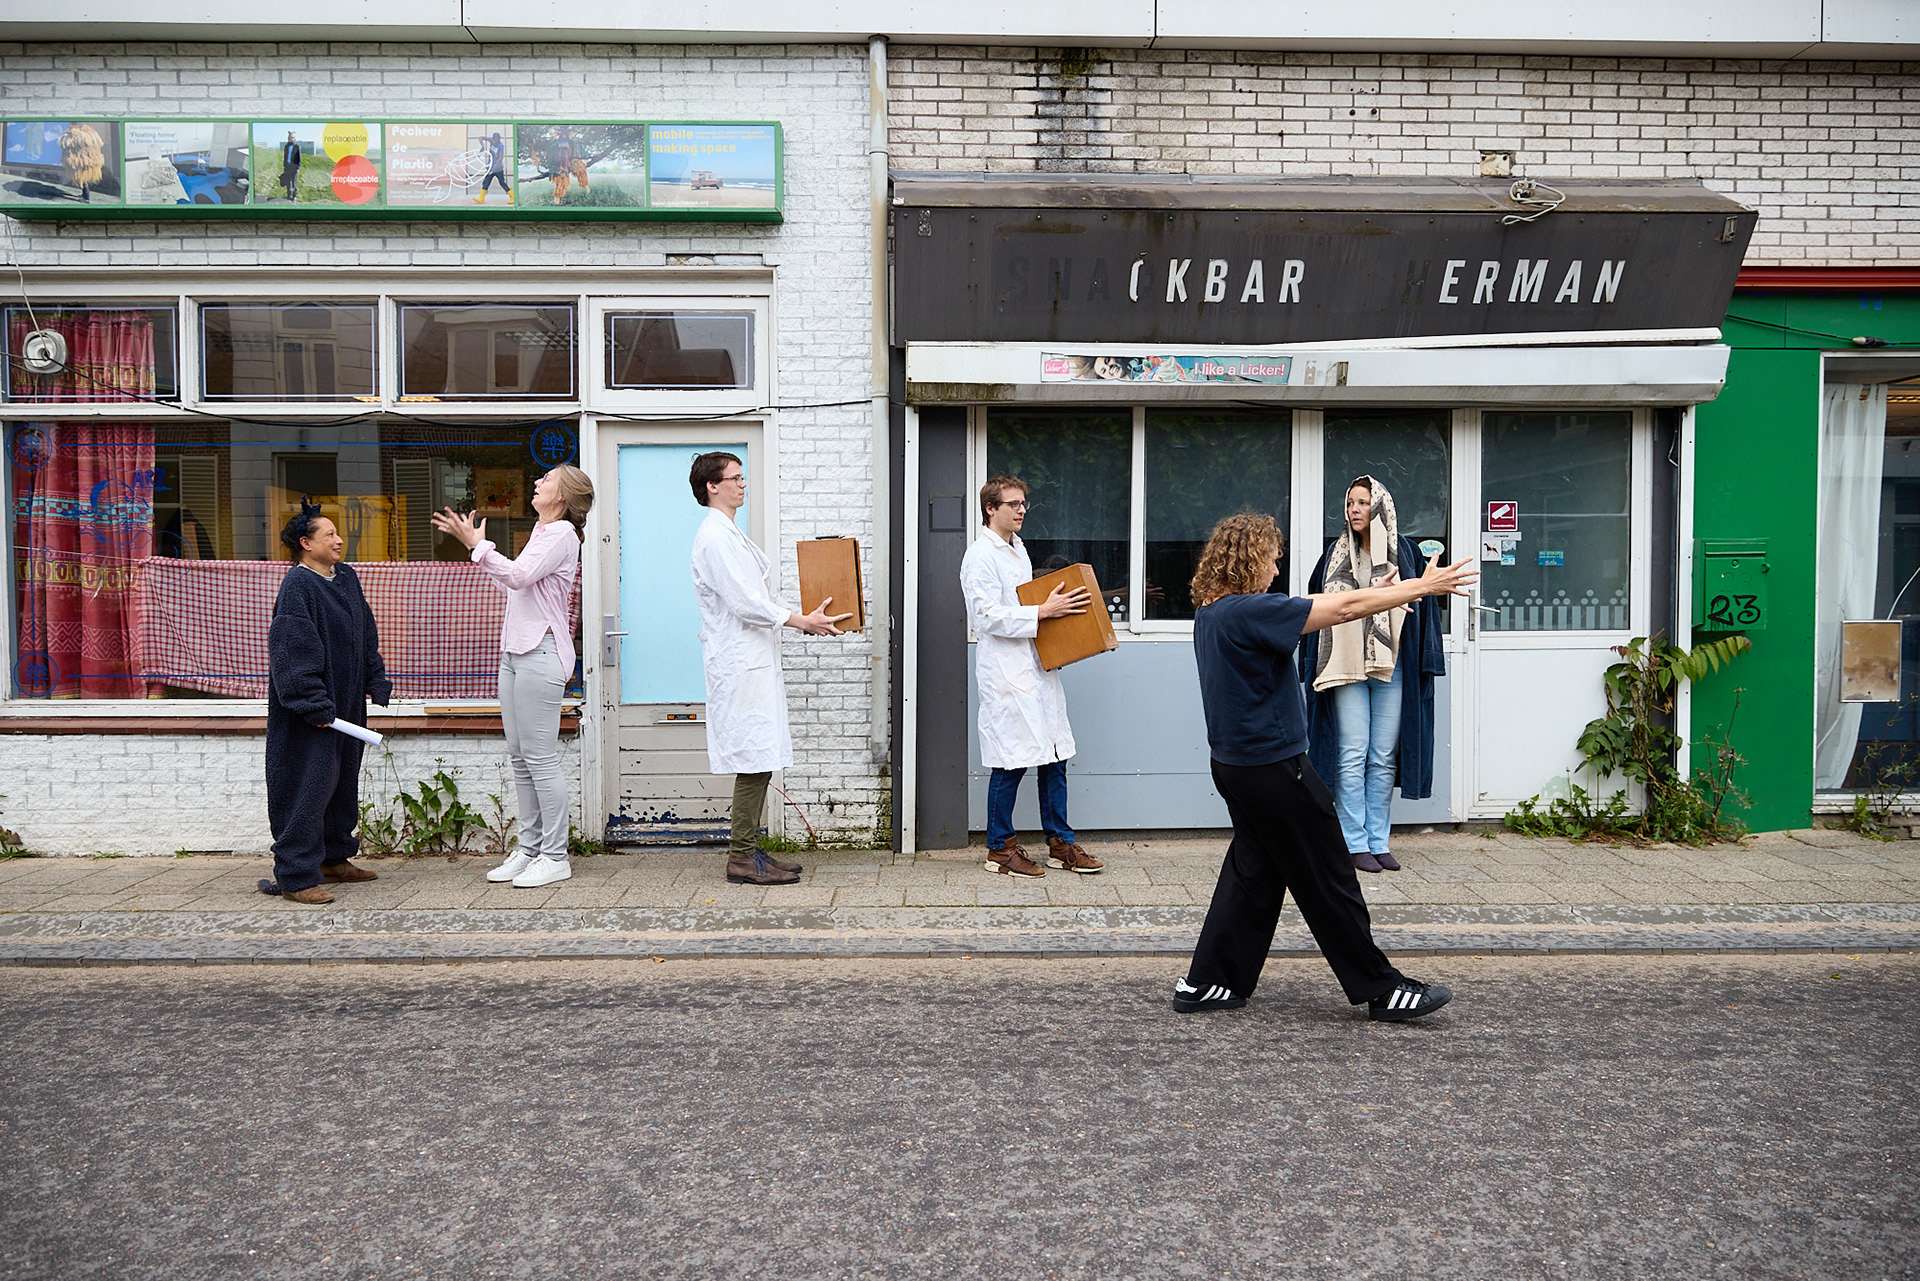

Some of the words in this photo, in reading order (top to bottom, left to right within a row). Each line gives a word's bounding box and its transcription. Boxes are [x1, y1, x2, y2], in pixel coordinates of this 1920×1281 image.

[391, 125, 442, 137] Pecheur
[652, 129, 693, 140] mobile
[324, 135, 367, 144] replaceable
[391, 142, 408, 153] de
[652, 143, 698, 156] making
[700, 144, 737, 154] space
[392, 158, 433, 170] Plastic
[331, 175, 379, 185] irreplaceable
[1194, 362, 1200, 375] I
[1202, 362, 1225, 375] like
[1228, 365, 1237, 375] a
[1240, 363, 1286, 376] Licker!
[1707, 595, 1761, 626] 23
